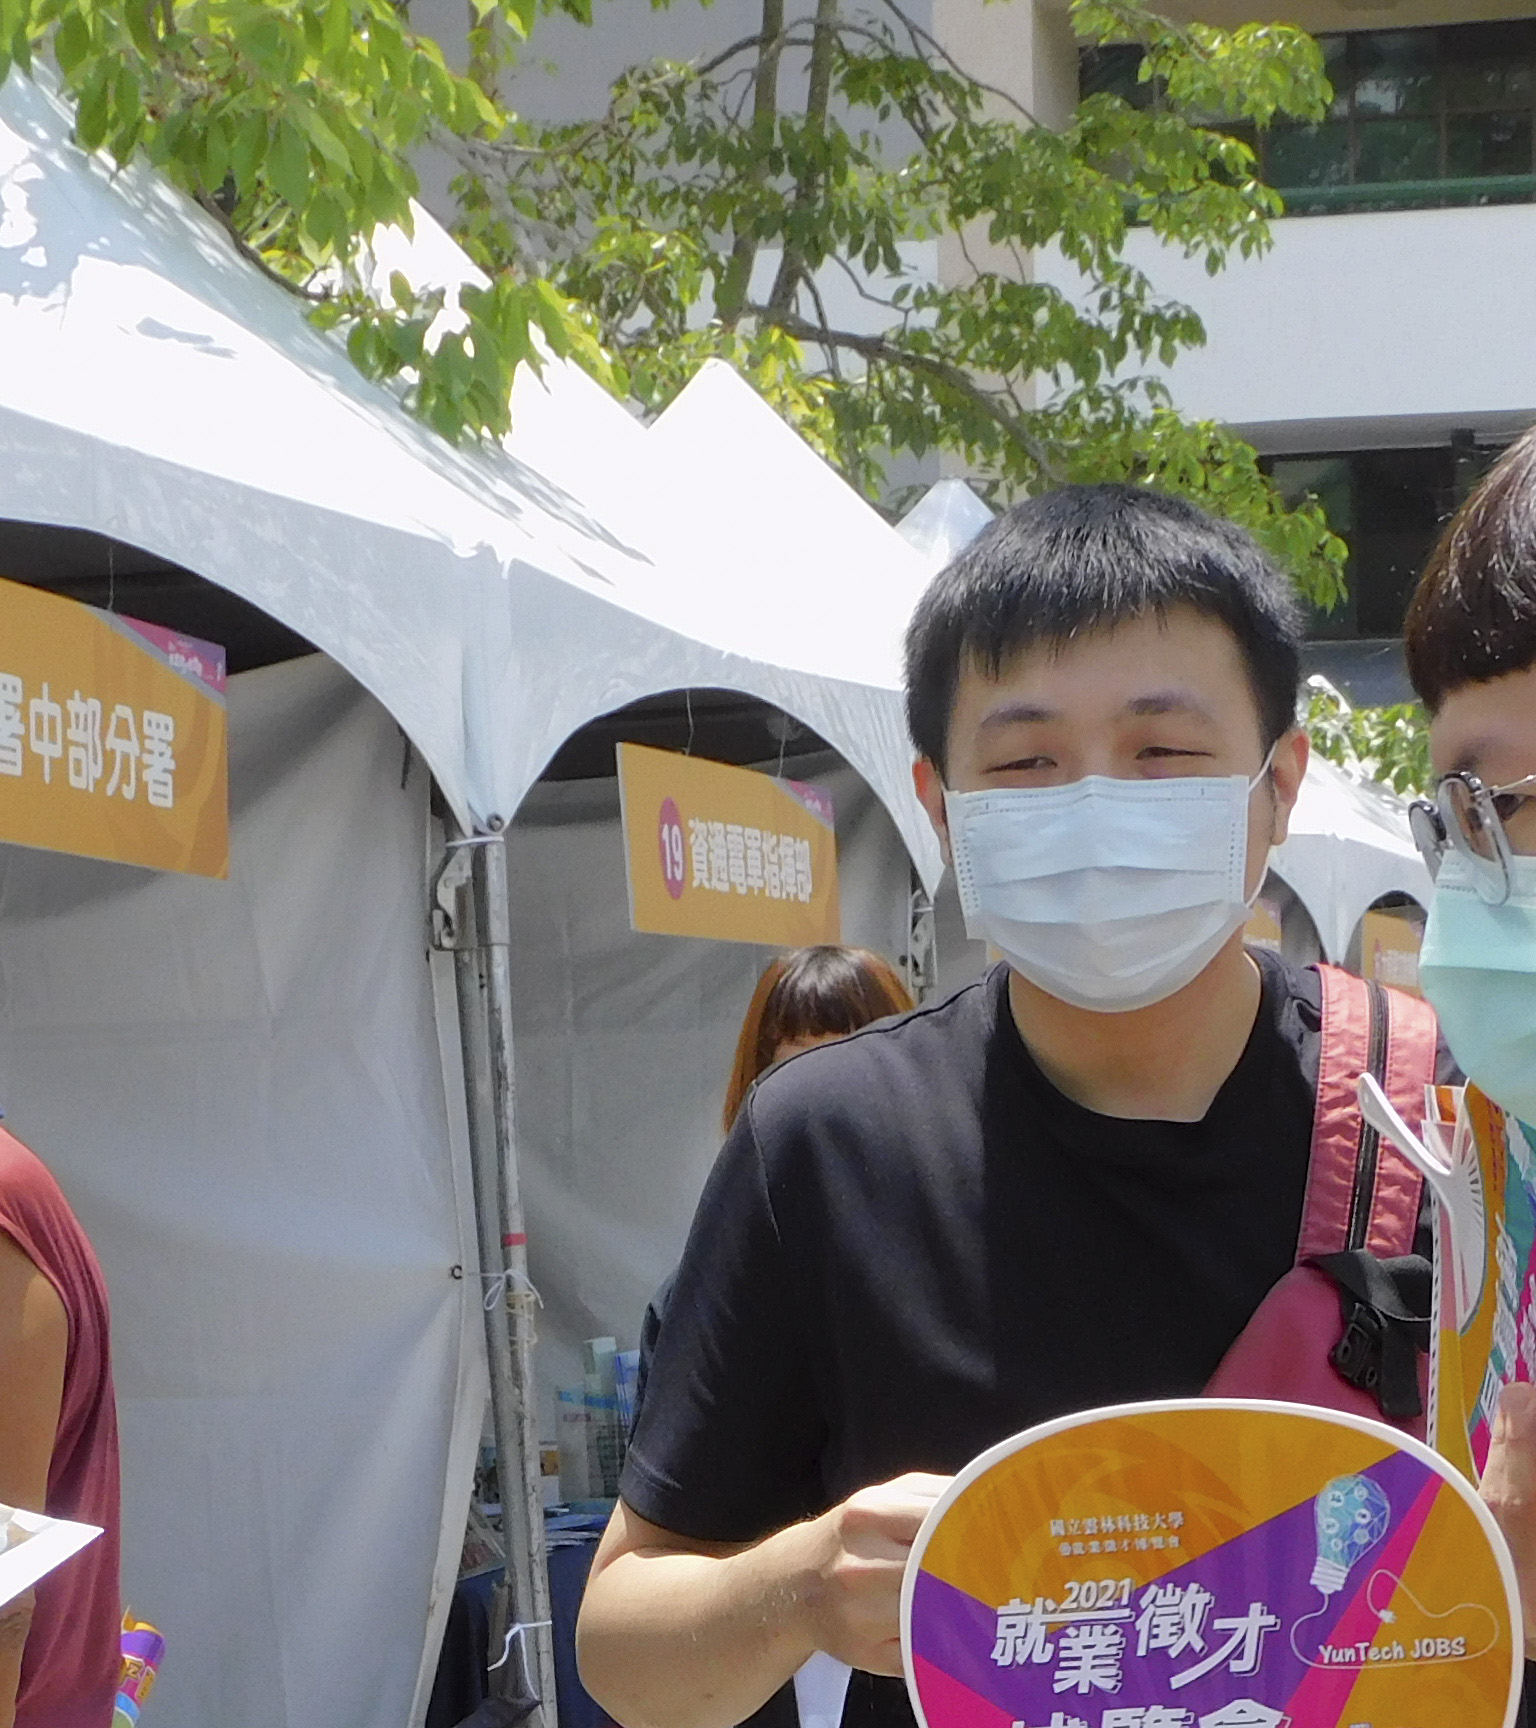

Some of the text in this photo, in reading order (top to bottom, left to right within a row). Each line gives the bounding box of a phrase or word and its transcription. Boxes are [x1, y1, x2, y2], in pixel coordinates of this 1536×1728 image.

[662, 823, 683, 882] 19
[1061, 1577, 1135, 1612] 2021
[990, 1582, 1281, 1695] 就業徵才
[1318, 1637, 1466, 1666] YunTech JOBS
